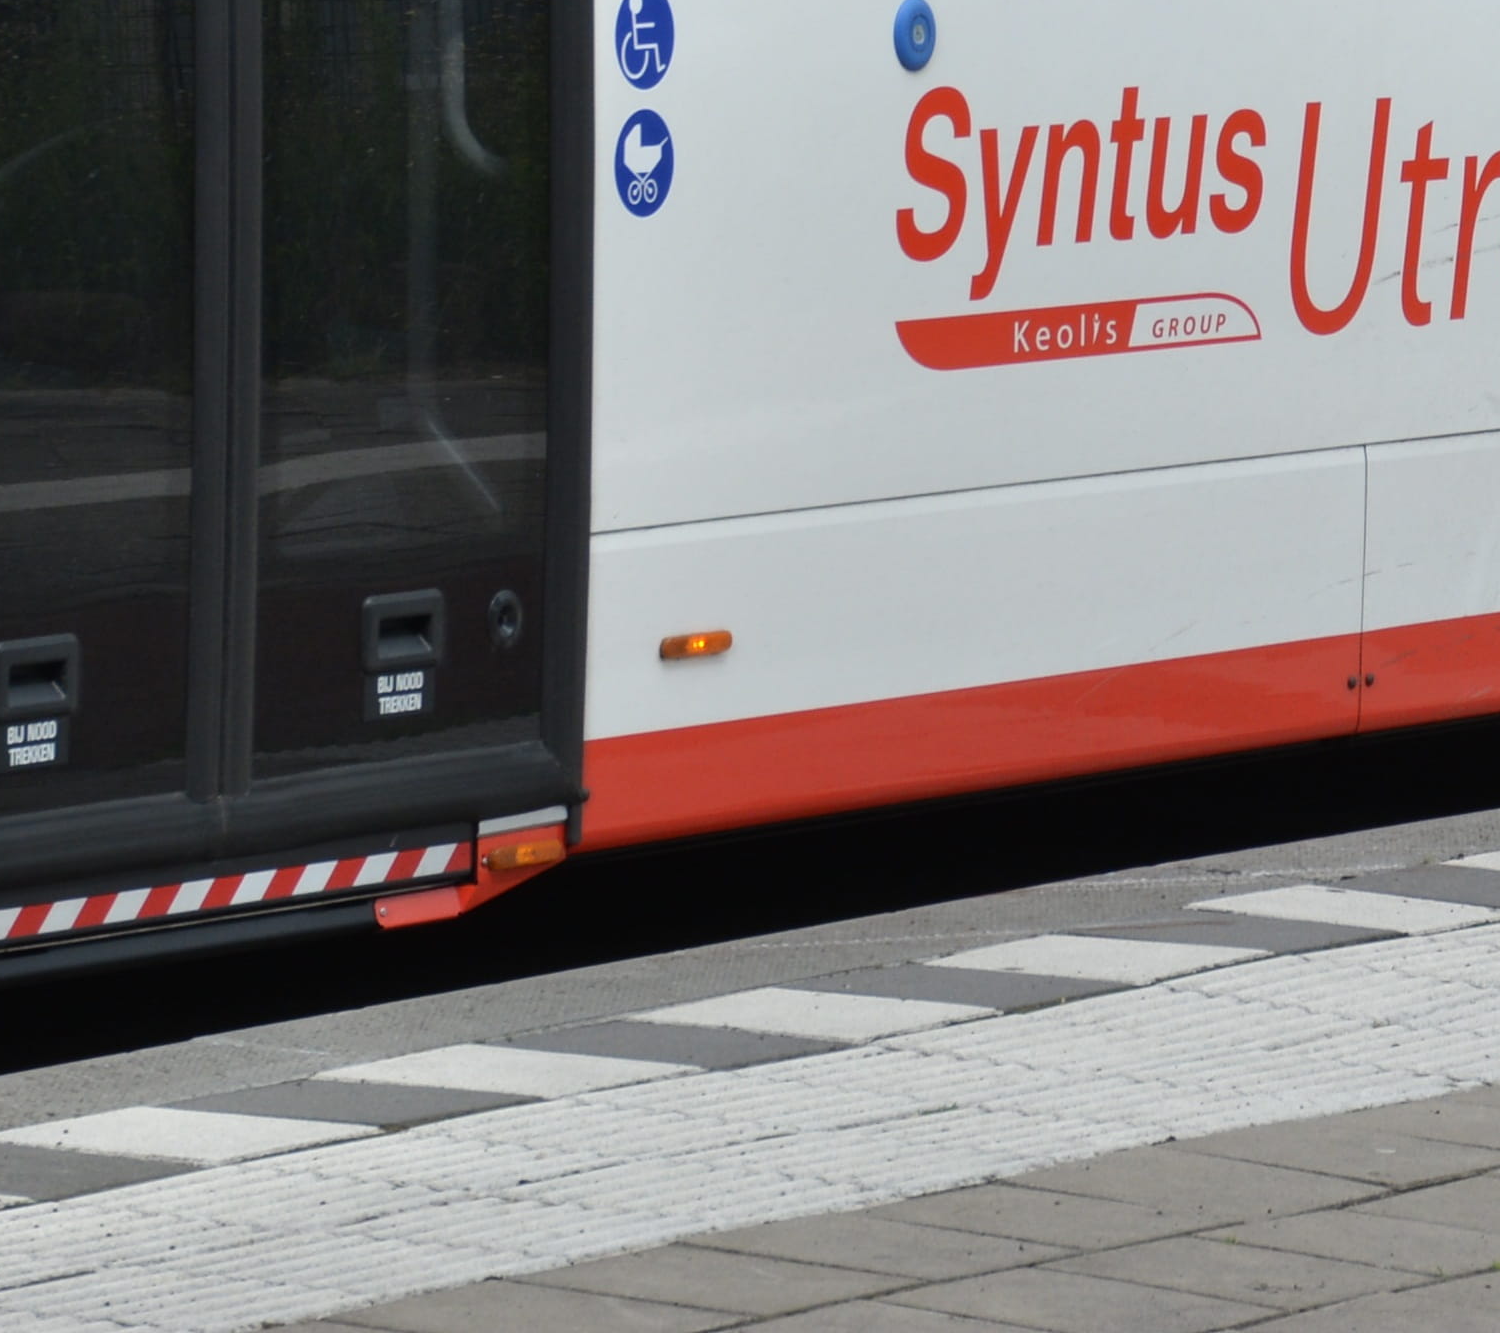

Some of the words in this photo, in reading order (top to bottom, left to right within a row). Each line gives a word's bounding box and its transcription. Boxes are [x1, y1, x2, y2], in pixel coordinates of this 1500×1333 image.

[896, 84, 1266, 299] Syntus
[1013, 313, 1117, 353] Keolis
[1152, 313, 1226, 339] GROUP
[377, 675, 394, 694] BIJ
[396, 671, 424, 691] NOOD
[378, 692, 422, 715] TREKKEN
[7, 725, 25, 745] BIJ
[27, 720, 57, 741] NOOD
[8, 742, 56, 767] TREKKEN
